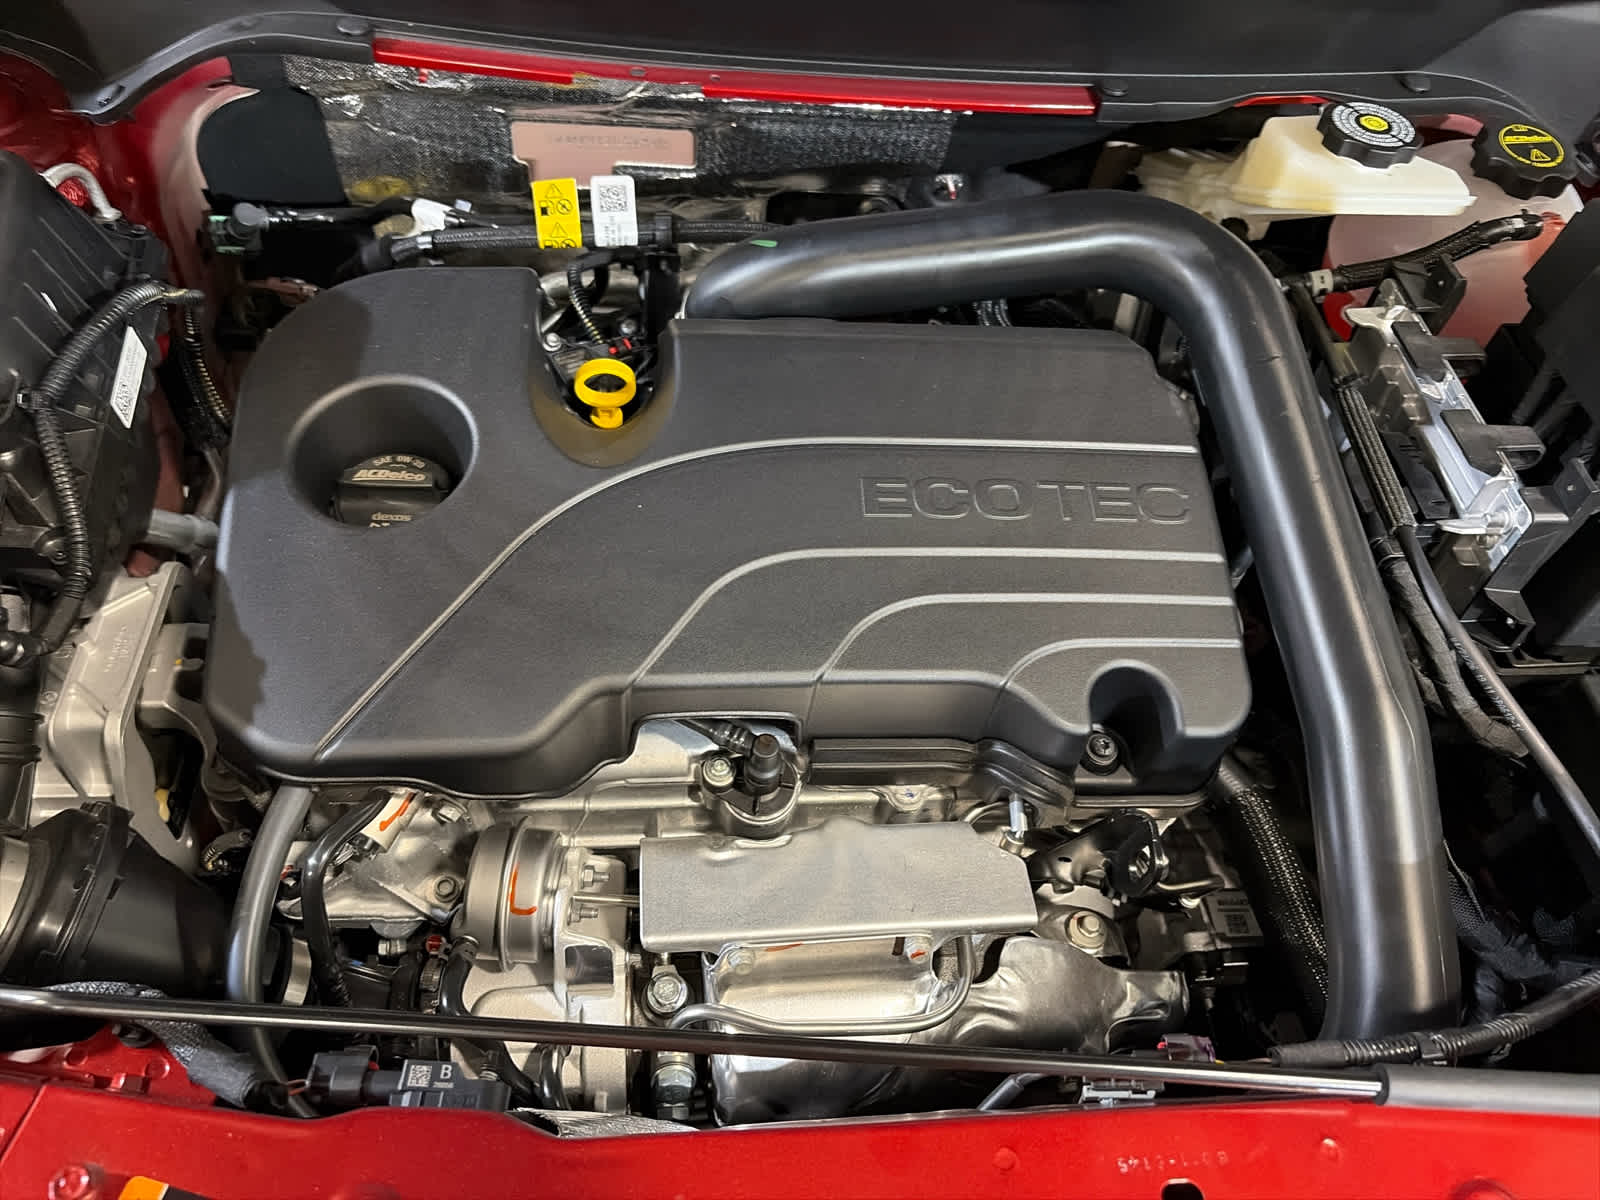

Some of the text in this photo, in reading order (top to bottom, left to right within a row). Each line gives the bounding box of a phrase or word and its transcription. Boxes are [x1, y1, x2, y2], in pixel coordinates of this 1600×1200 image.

[352, 469, 427, 481] ACDelco
[859, 477, 1191, 525] ECOTEC
[439, 1064, 453, 1079] B
